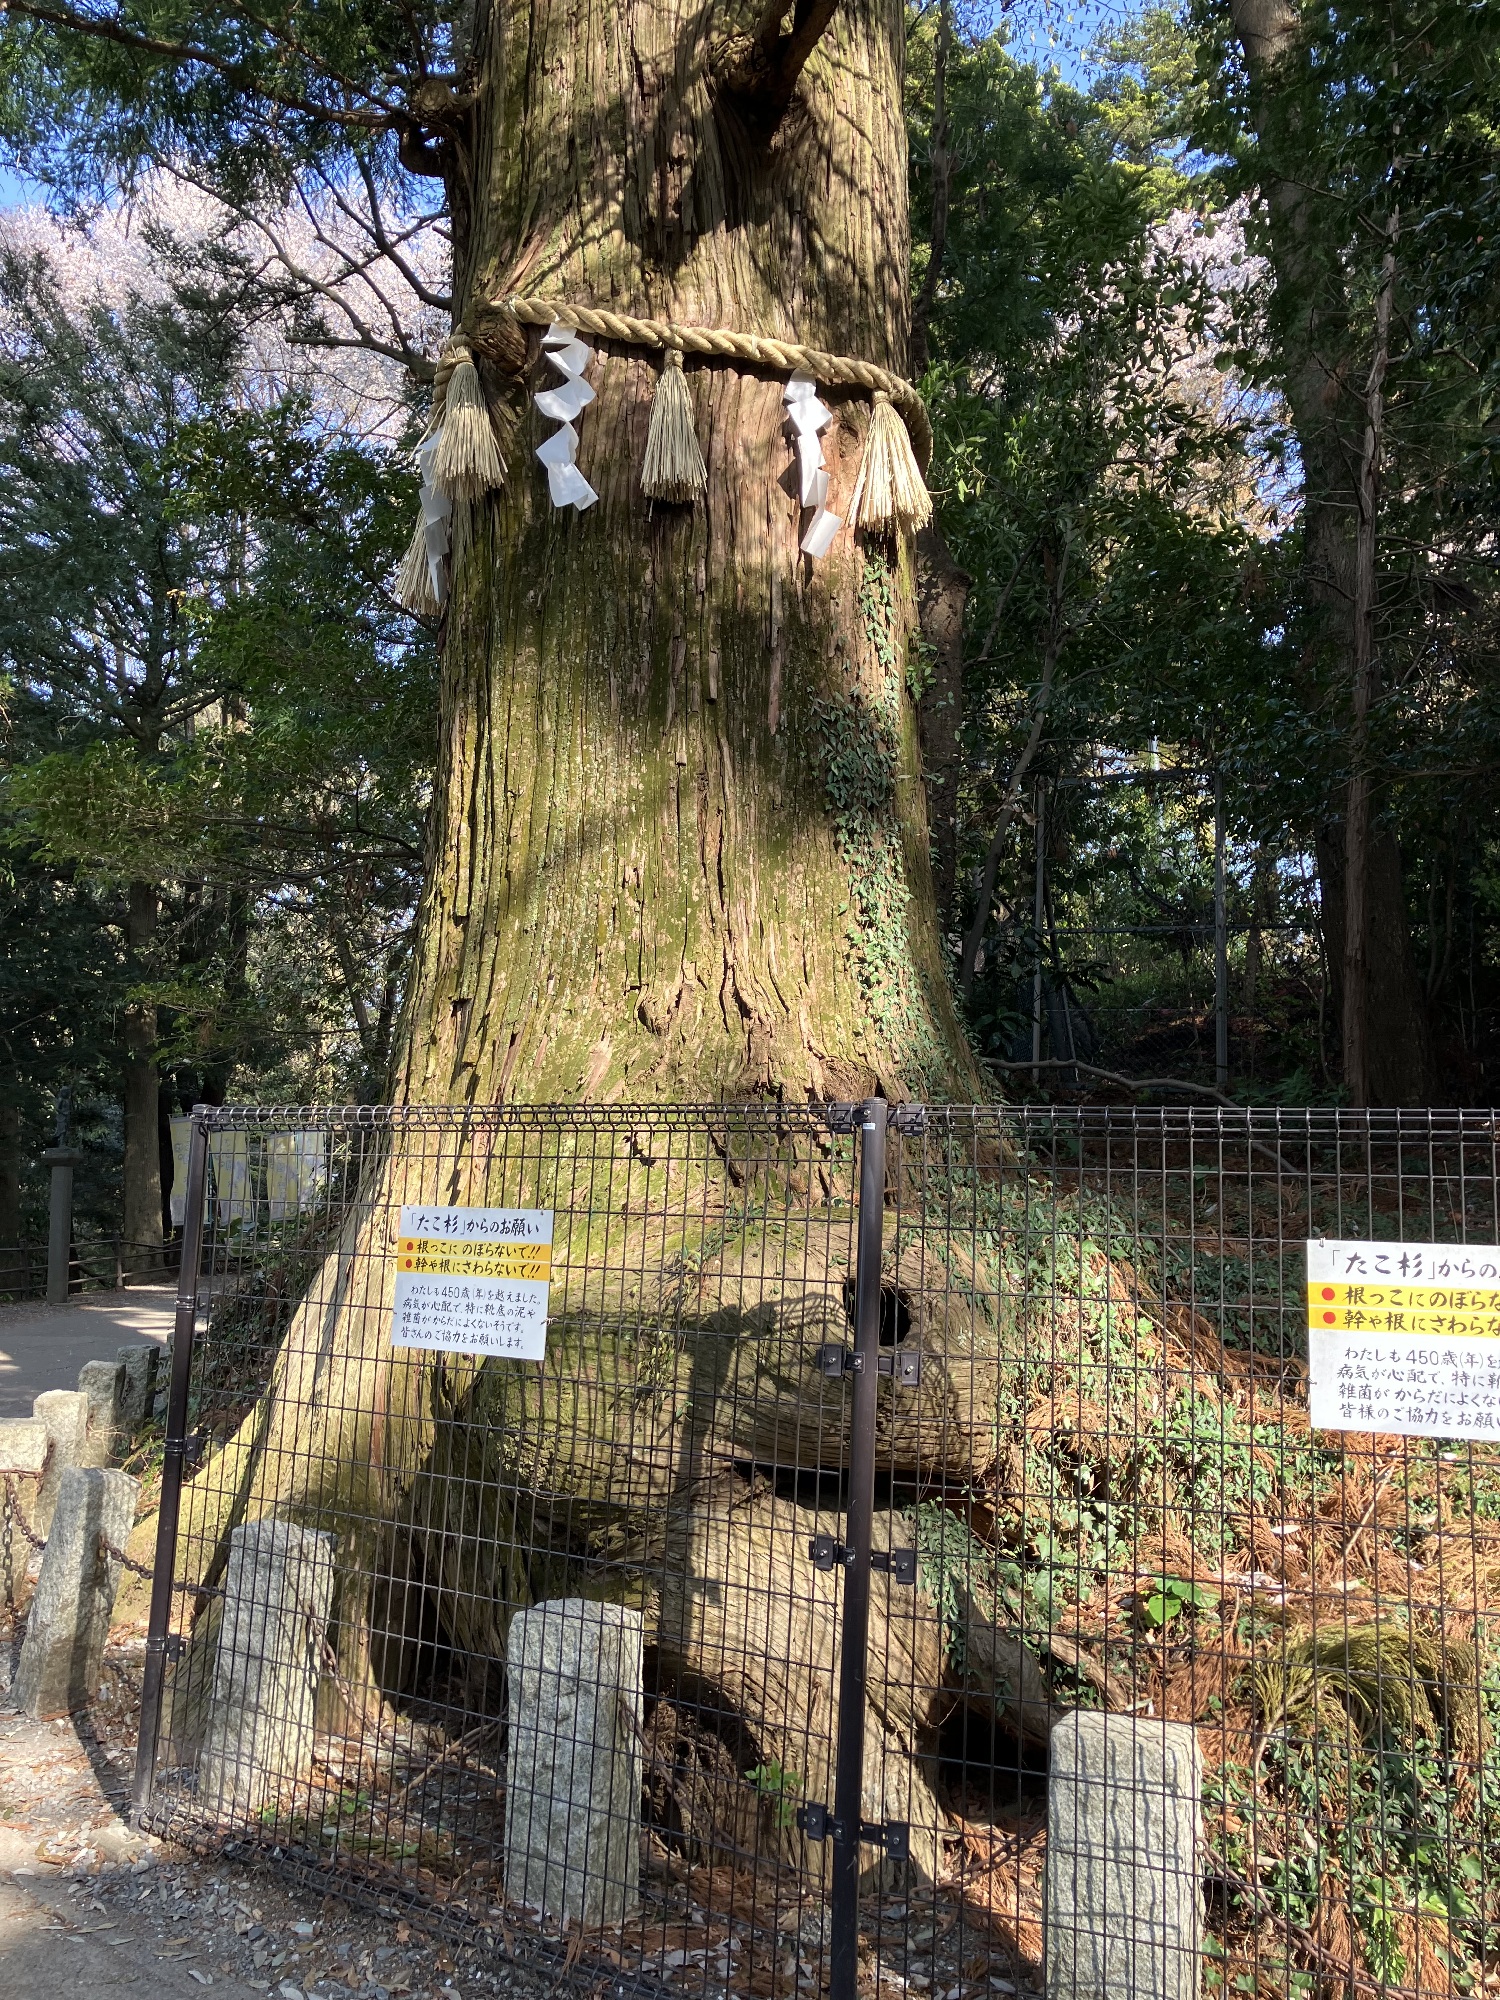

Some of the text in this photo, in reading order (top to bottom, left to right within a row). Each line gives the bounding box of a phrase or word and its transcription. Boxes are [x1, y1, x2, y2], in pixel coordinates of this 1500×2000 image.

[410, 1212, 539, 1237] 「たこ杉」からのお願い
[1332, 1249, 1500, 1280] 「たこ杉」からの
[1344, 1347, 1500, 1370] わたしも450歳(年)を
[1339, 1382, 1500, 1408] 雑菌がからだによくな
[1339, 1402, 1500, 1429] 皆様のご協力をお願
